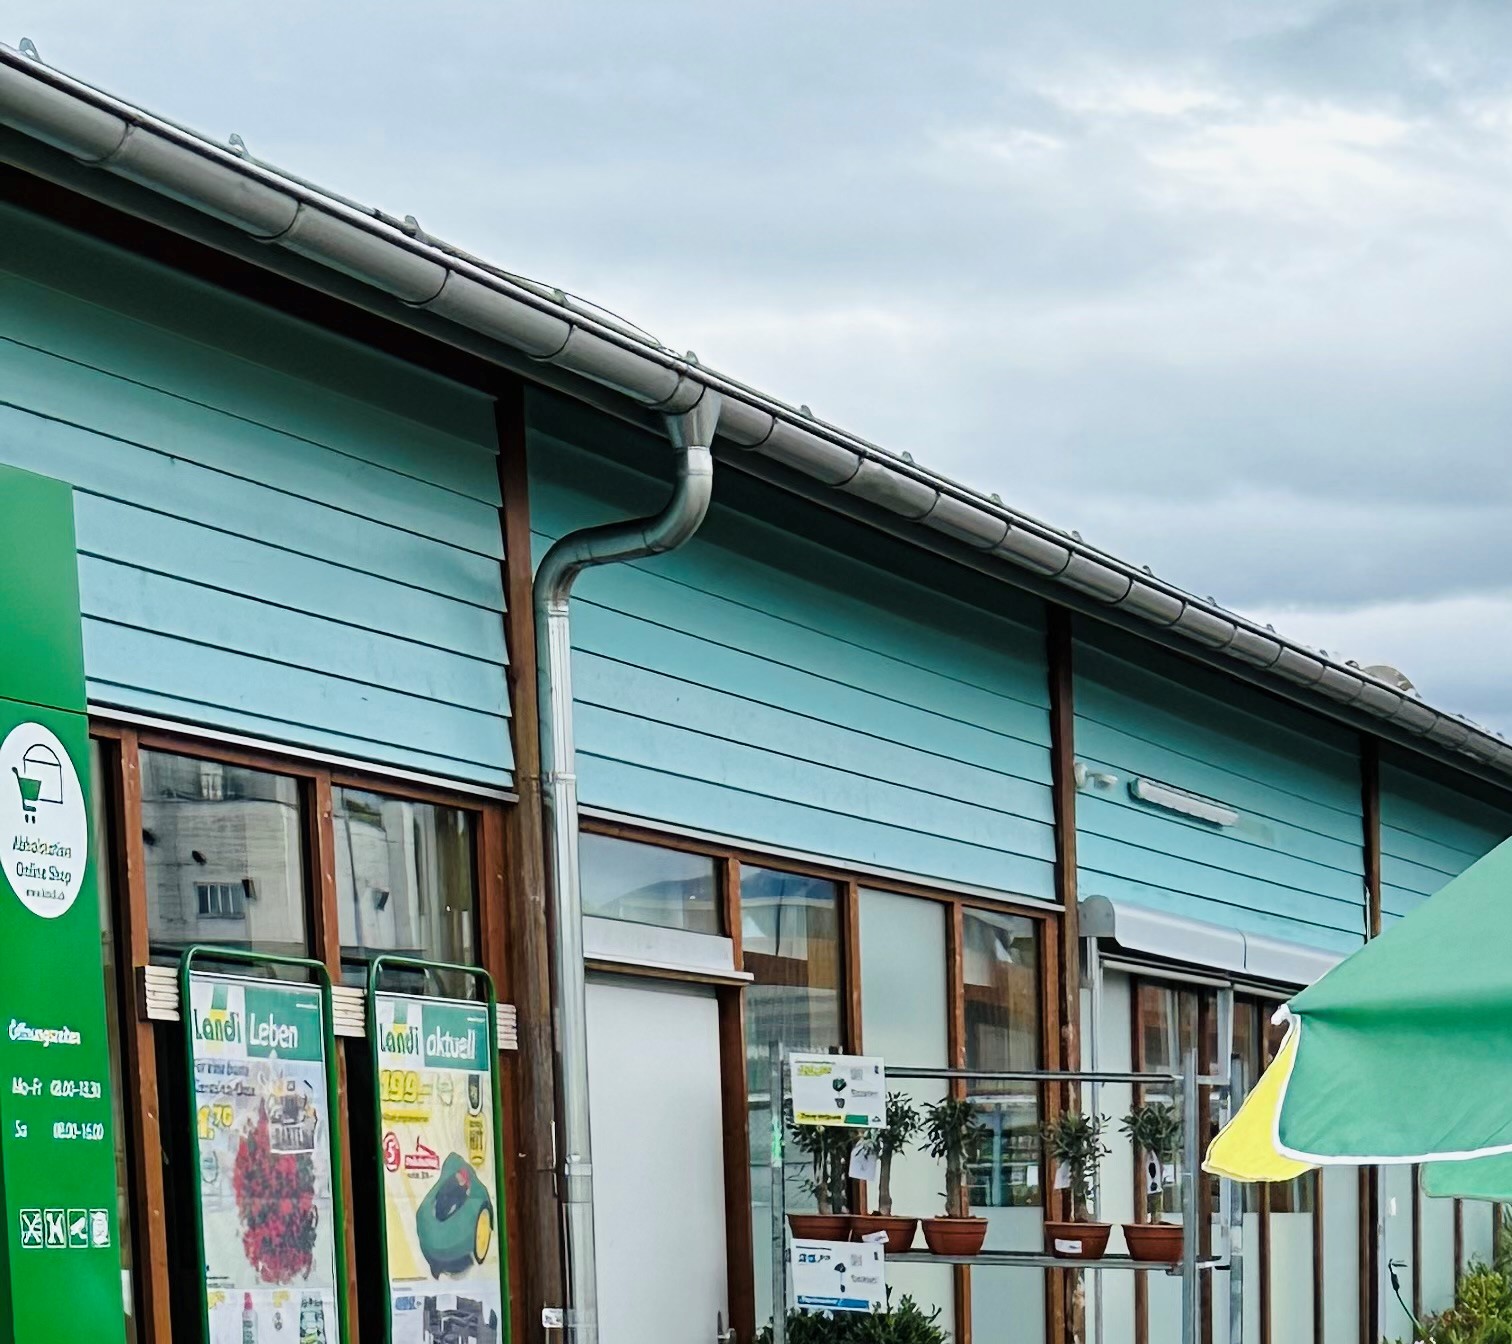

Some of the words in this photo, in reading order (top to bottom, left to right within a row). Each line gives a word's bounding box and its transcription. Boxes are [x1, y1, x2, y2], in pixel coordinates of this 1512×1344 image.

[193, 1008, 242, 1044] Landi
[250, 1012, 299, 1049] Leben
[379, 1022, 420, 1056] Landi
[426, 1026, 476, 1060] aktuell
